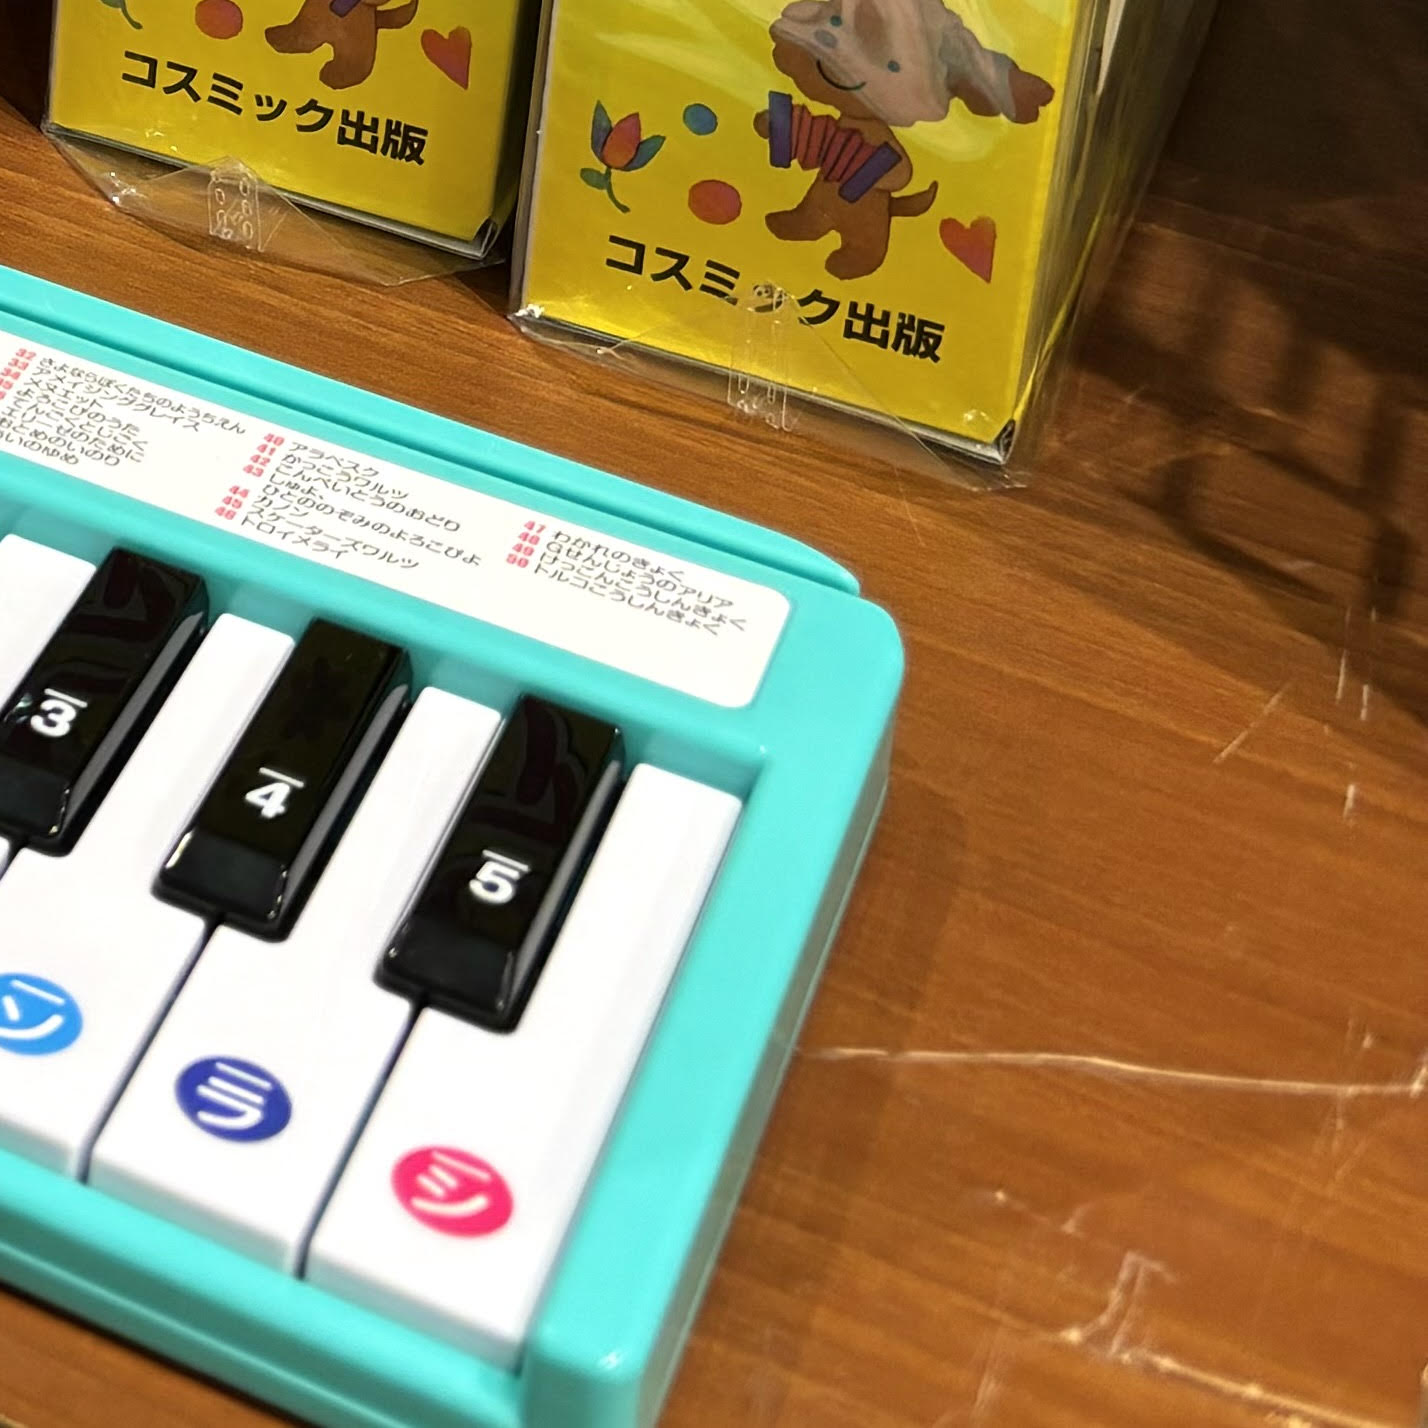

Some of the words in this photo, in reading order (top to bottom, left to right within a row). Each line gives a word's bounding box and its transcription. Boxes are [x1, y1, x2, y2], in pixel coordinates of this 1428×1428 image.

[121, 50, 429, 167] コスミック出版
[605, 233, 946, 365] コスミック出版
[29, 699, 78, 738] 3
[244, 782, 291, 820] 4
[468, 862, 520, 904] 5
